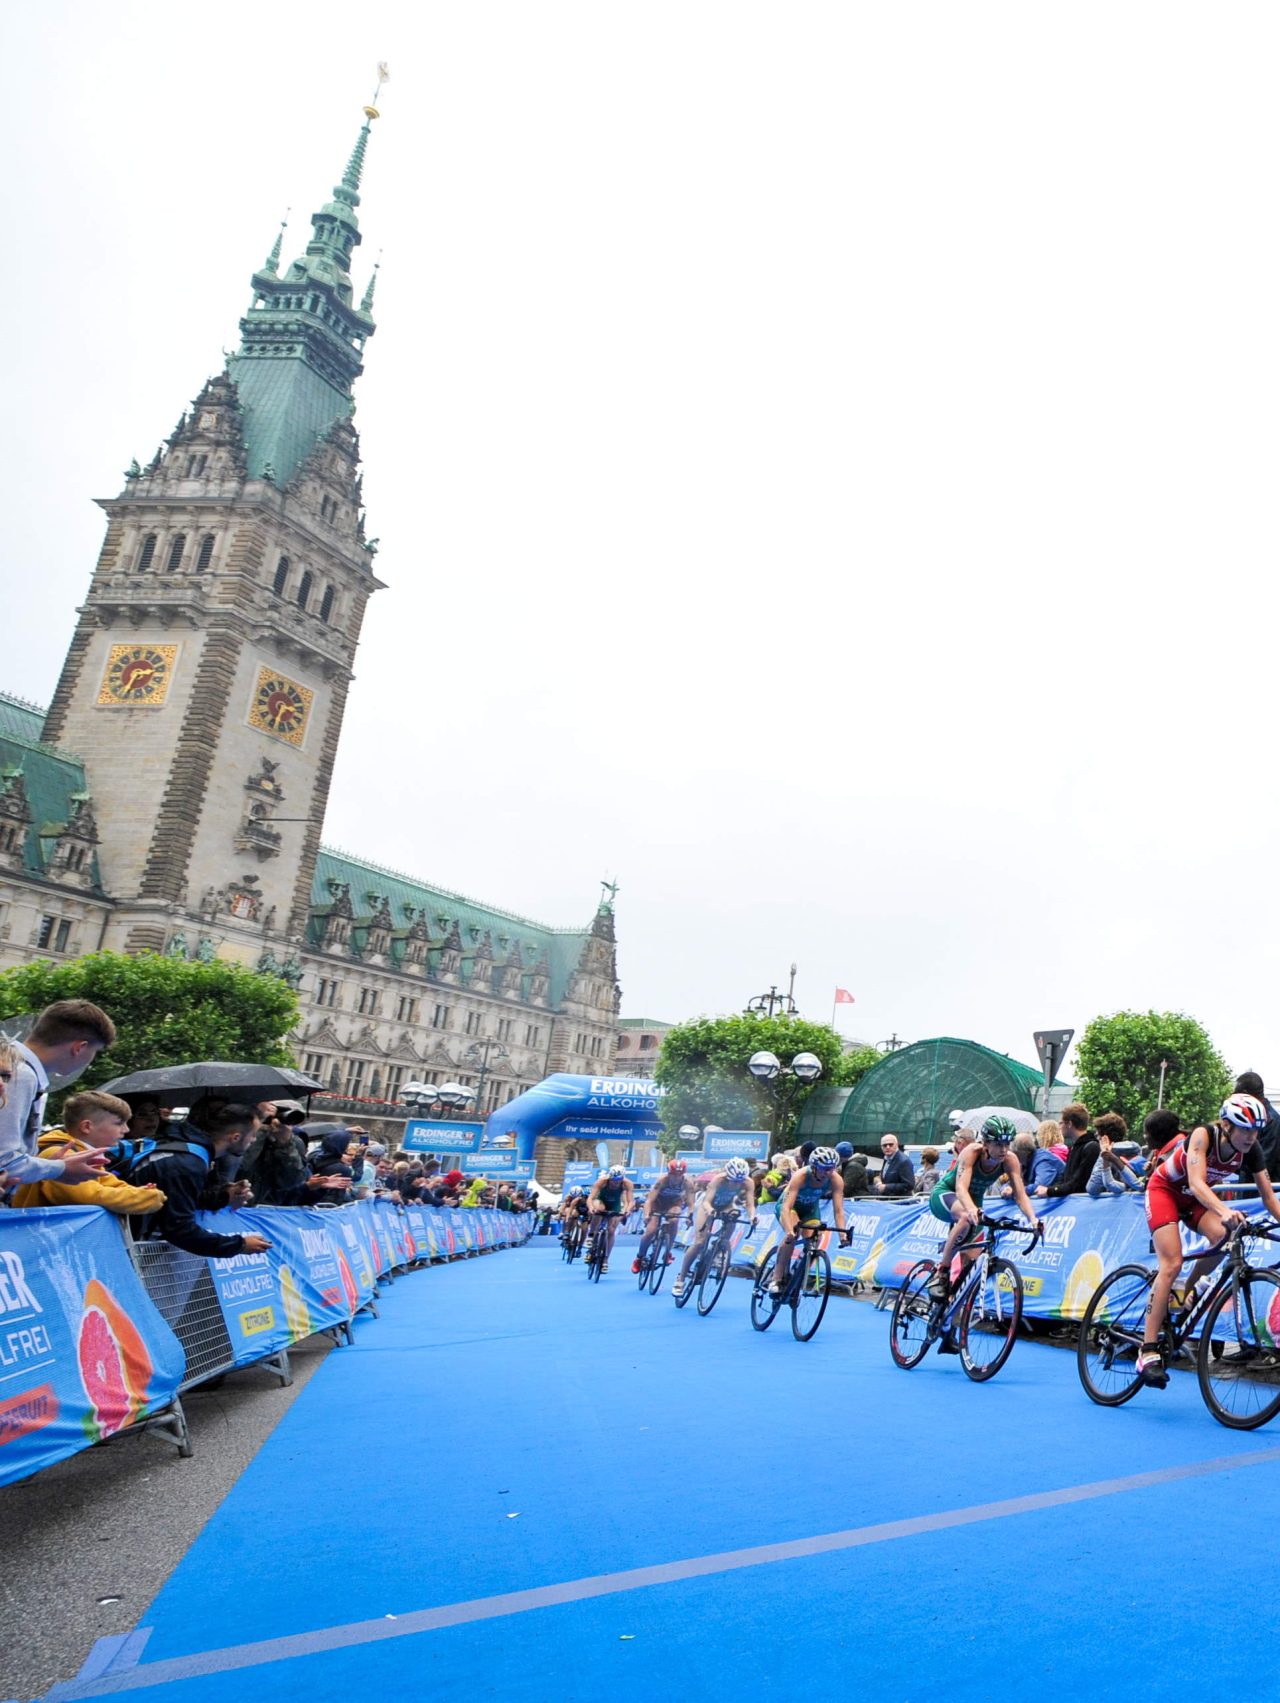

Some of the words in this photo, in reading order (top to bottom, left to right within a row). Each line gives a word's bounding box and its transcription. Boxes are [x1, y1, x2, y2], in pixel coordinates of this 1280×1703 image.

[590, 1079, 668, 1097] ERDING
[587, 1097, 657, 1109] ALKOHO
[413, 1127, 464, 1140] ERDINGER
[580, 1126, 598, 1134] seid
[600, 1126, 633, 1135] Helden!
[644, 1128, 657, 1136] Yo
[222, 1273, 274, 1299] ALKOHOLFREI
